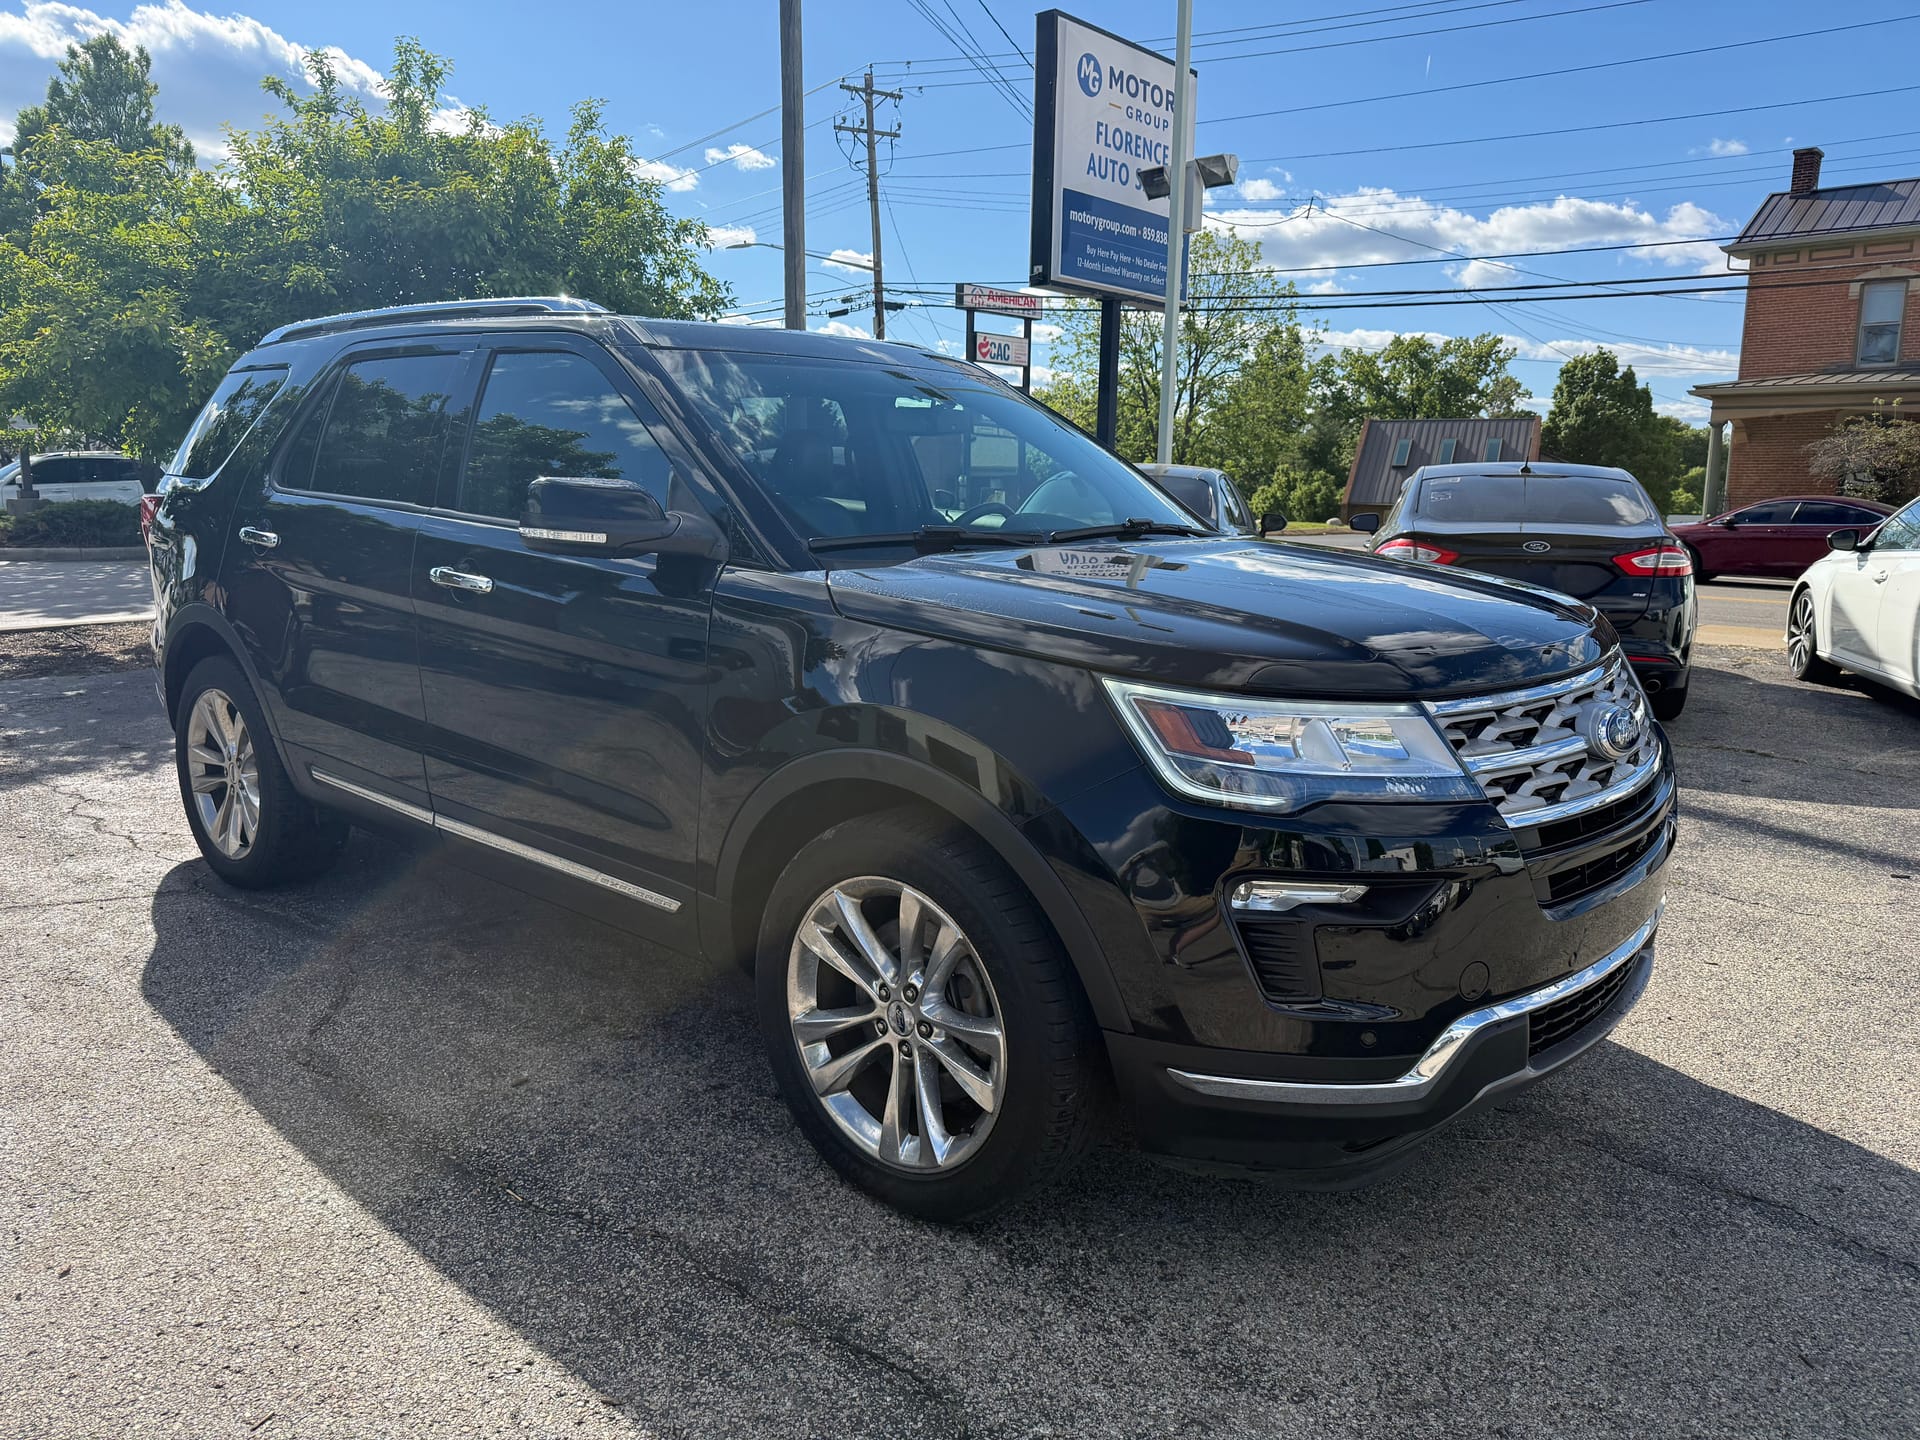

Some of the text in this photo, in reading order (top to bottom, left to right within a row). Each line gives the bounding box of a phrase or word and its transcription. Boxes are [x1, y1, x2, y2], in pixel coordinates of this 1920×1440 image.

[1126, 105, 1169, 131] GROUP
[1096, 121, 1169, 166] FLORENCE
[1086, 152, 1129, 186] AUTO
[1069, 209, 1137, 236] motorygroup.com
[1077, 256, 1101, 271] 12-Month
[1101, 263, 1120, 276] Limited
[1121, 267, 1142, 283] Warranty
[1150, 274, 1165, 285] Select
[1086, 244, 1096, 258] Buy
[1097, 247, 1109, 259] Here
[1110, 250, 1119, 263] Pay
[1120, 252, 1131, 263] Here
[1135, 257, 1142, 266] No
[1143, 259, 1158, 270] Dealer
[989, 341, 1010, 361] CAC
